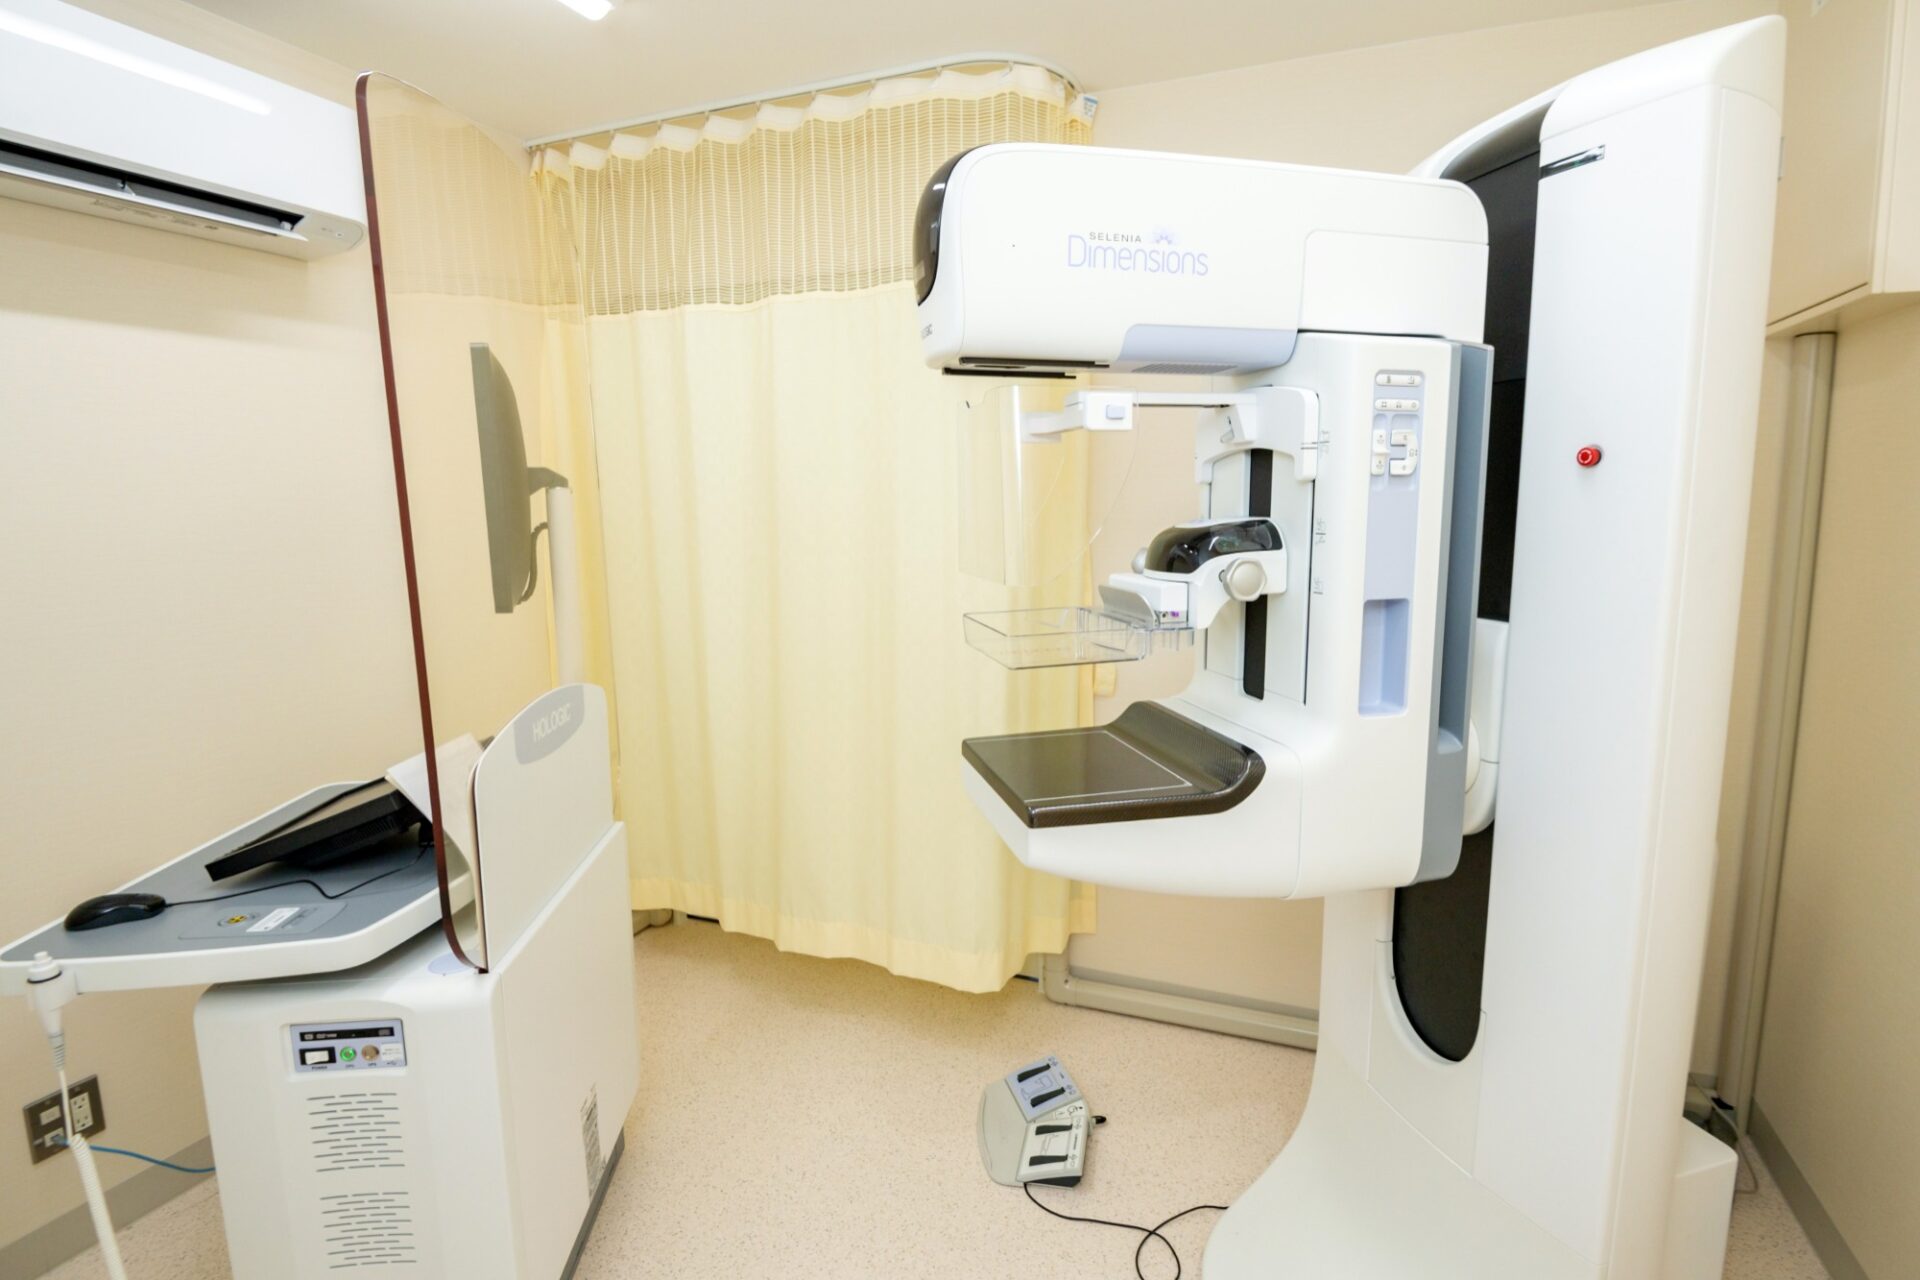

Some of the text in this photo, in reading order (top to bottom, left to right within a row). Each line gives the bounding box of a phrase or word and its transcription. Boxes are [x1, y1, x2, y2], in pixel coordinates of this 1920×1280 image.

[1068, 234, 1209, 276] Dimensions
[1089, 231, 1142, 243] SELENIA
[532, 703, 571, 743] HOLOGIC
